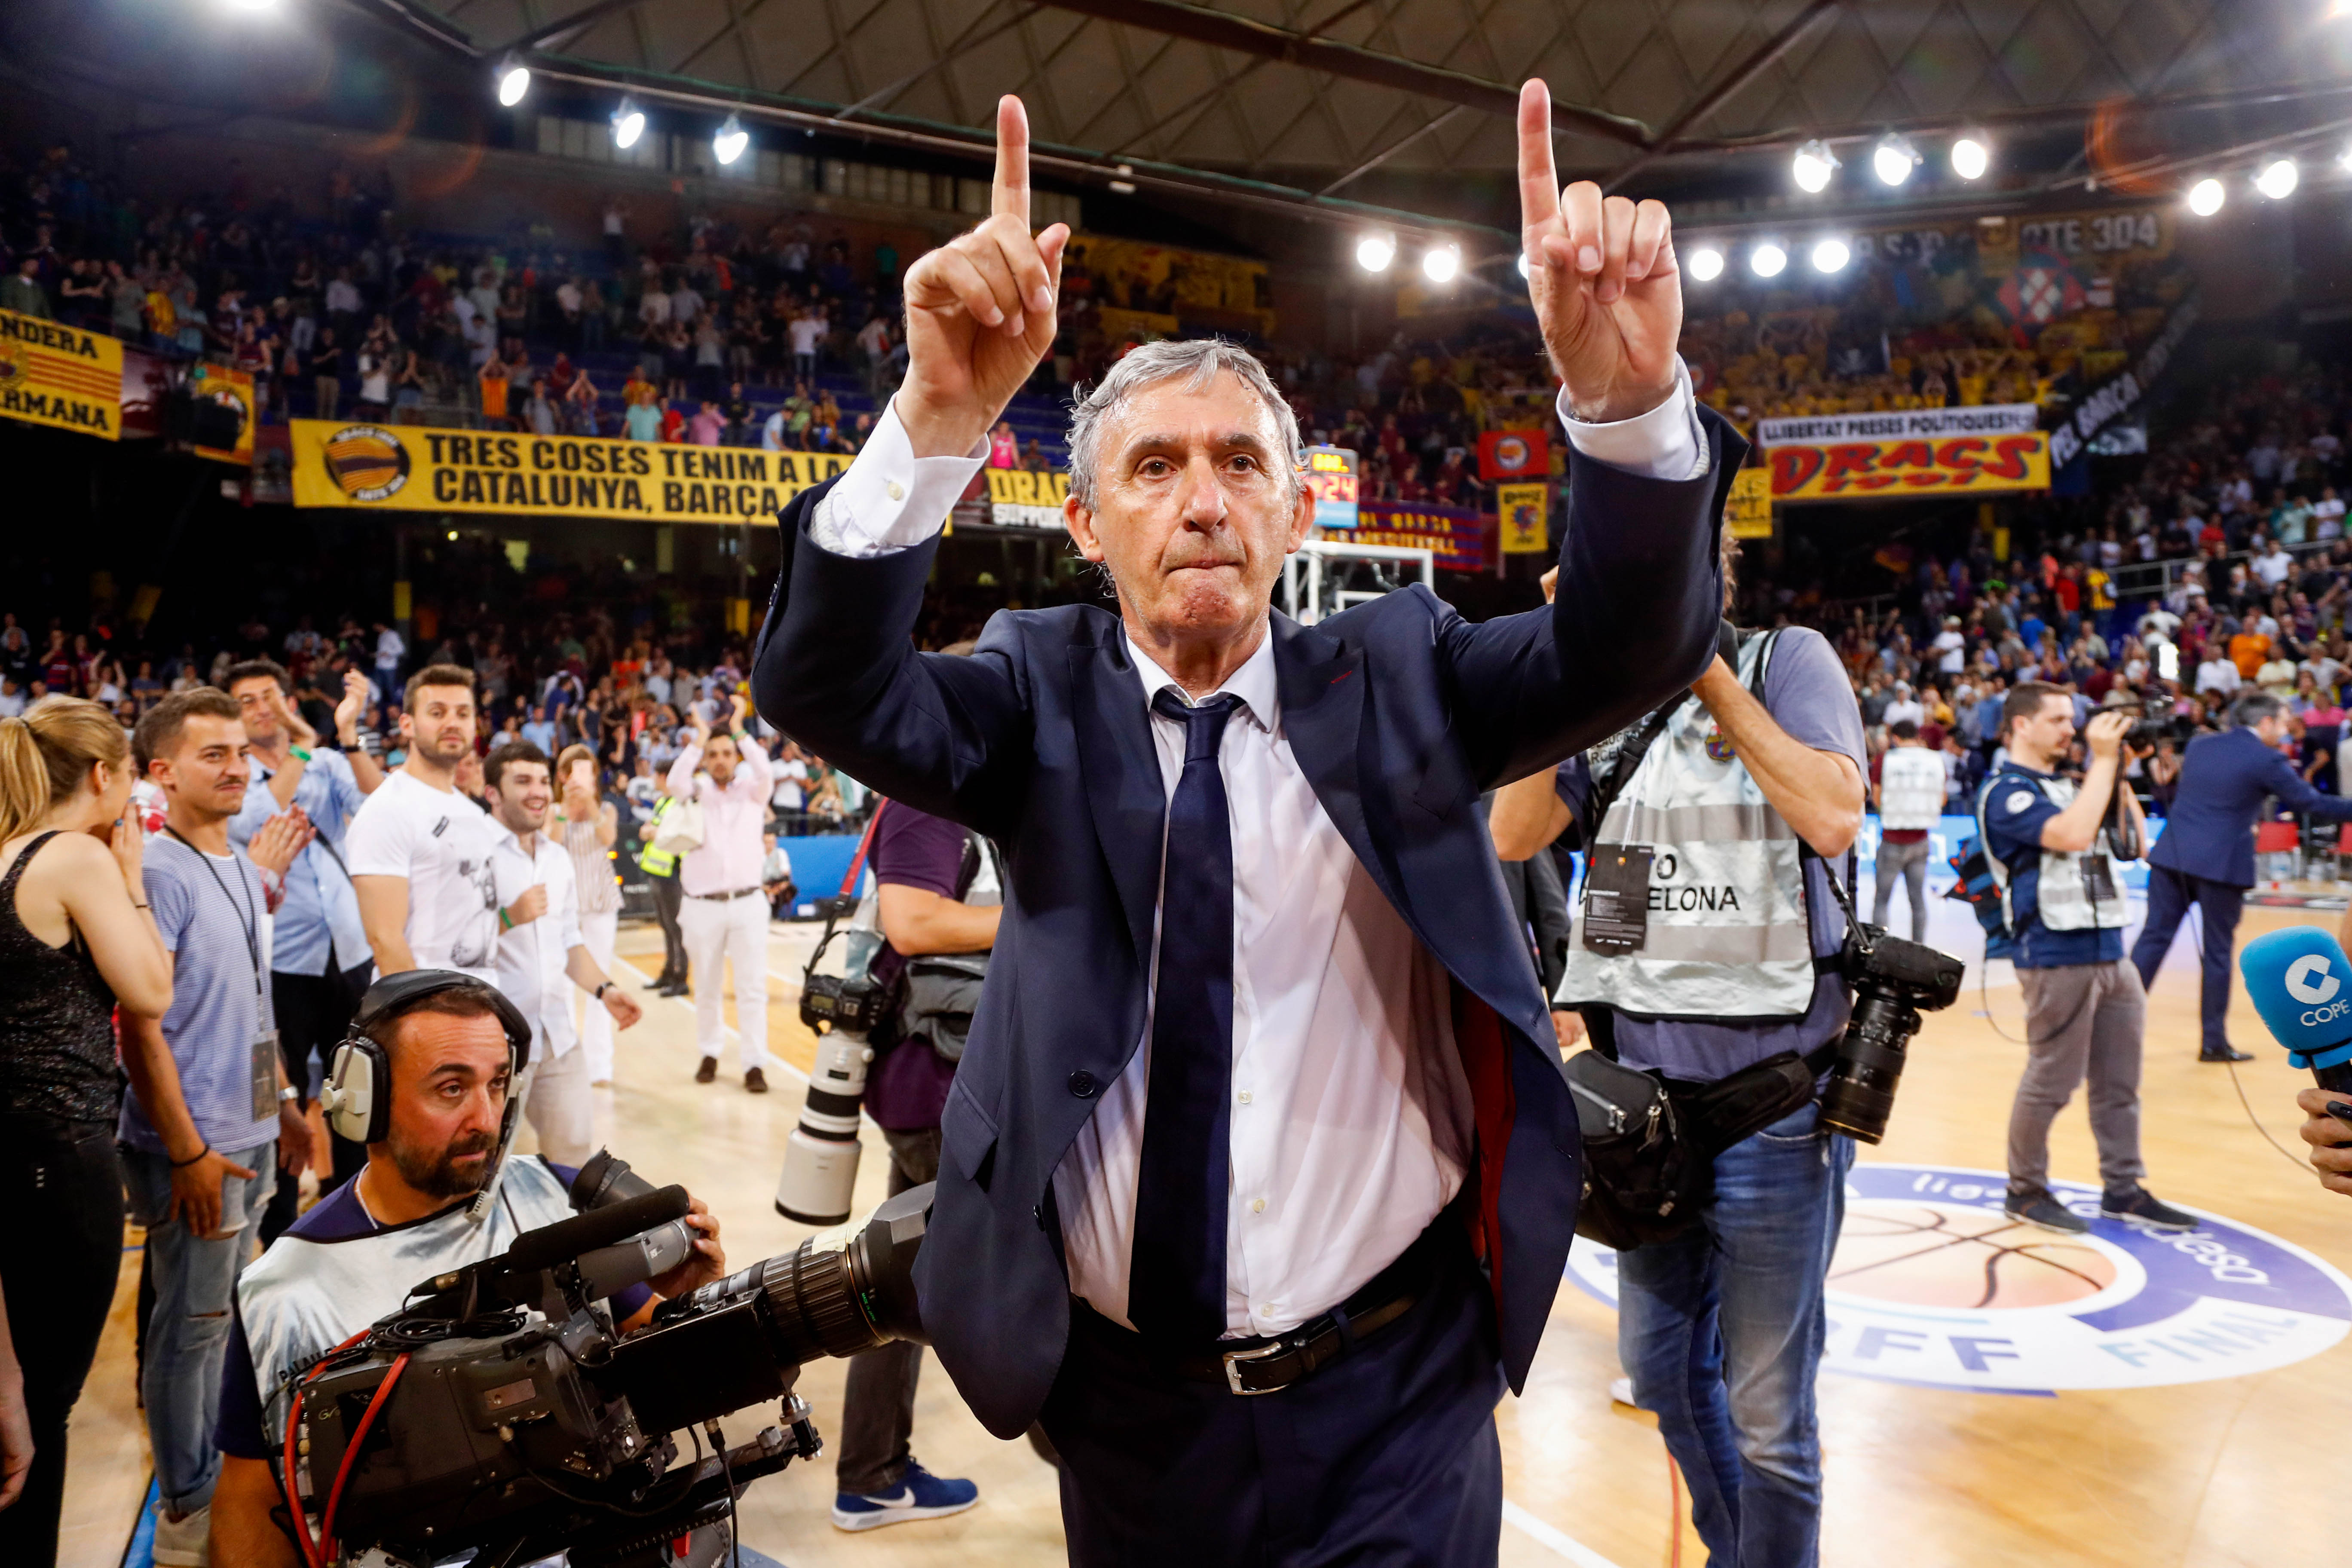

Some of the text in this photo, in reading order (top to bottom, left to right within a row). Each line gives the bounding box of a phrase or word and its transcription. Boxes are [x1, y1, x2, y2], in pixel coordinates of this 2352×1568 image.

[2092, 213, 2158, 251] 304
[2, 388, 109, 431] RMANA
[425, 433, 520, 468] TRES
[532, 440, 650, 475] COSES
[660, 448, 767, 481] TENIM
[778, 456, 799, 483] A
[1771, 435, 2041, 495] DRACS
[433, 467, 652, 514] CATALUNYA,
[1323, 474, 1357, 504] 24
[1647, 886, 1740, 911] ELONA
[2300, 999, 2351, 1027] COPE
[2097, 1310, 2300, 1369] FINAL
